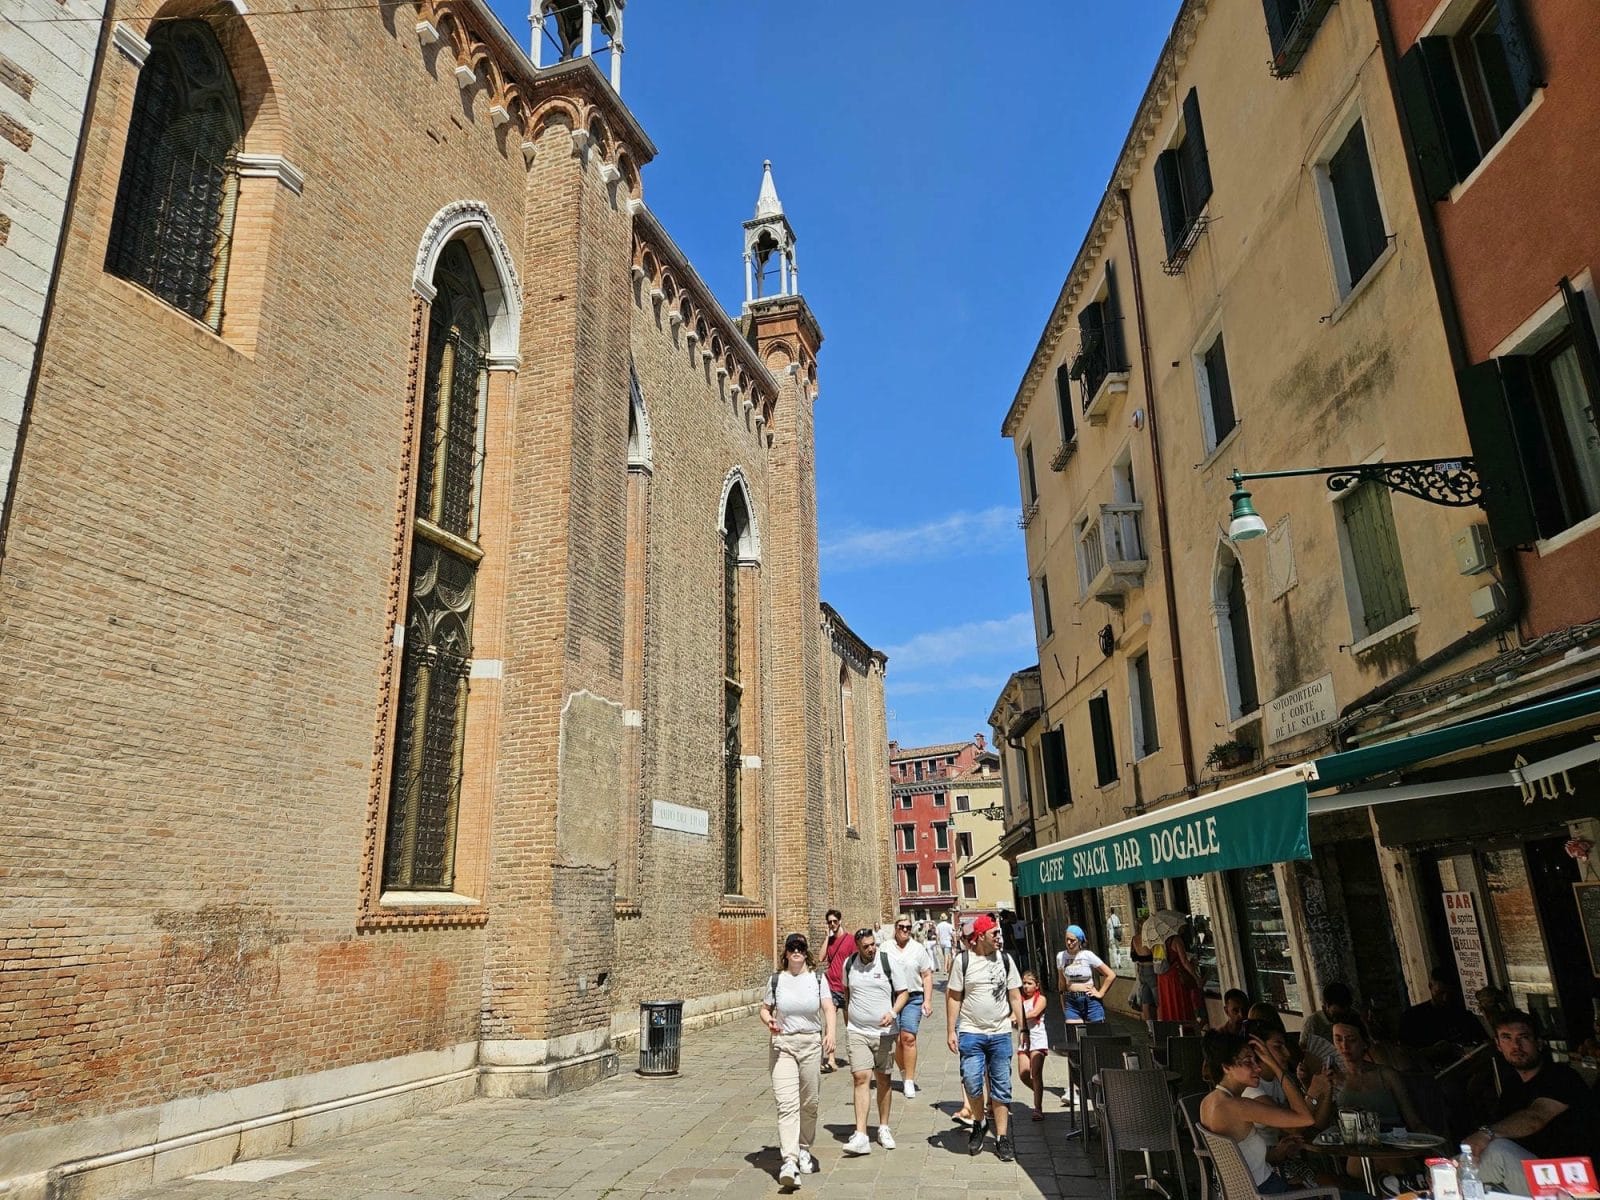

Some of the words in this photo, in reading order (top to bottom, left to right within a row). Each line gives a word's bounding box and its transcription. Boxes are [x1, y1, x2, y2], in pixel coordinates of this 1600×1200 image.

[1272, 683, 1323, 712] SOTOPORTEGO
[1281, 712, 1286, 722] E
[1289, 700, 1315, 719] CORTE
[1301, 709, 1326, 728] SCALE
[1072, 846, 1110, 878] SNACK
[1113, 837, 1143, 871] BAR
[1150, 816, 1220, 865] DOGALE
[1446, 894, 1471, 909] BAR
